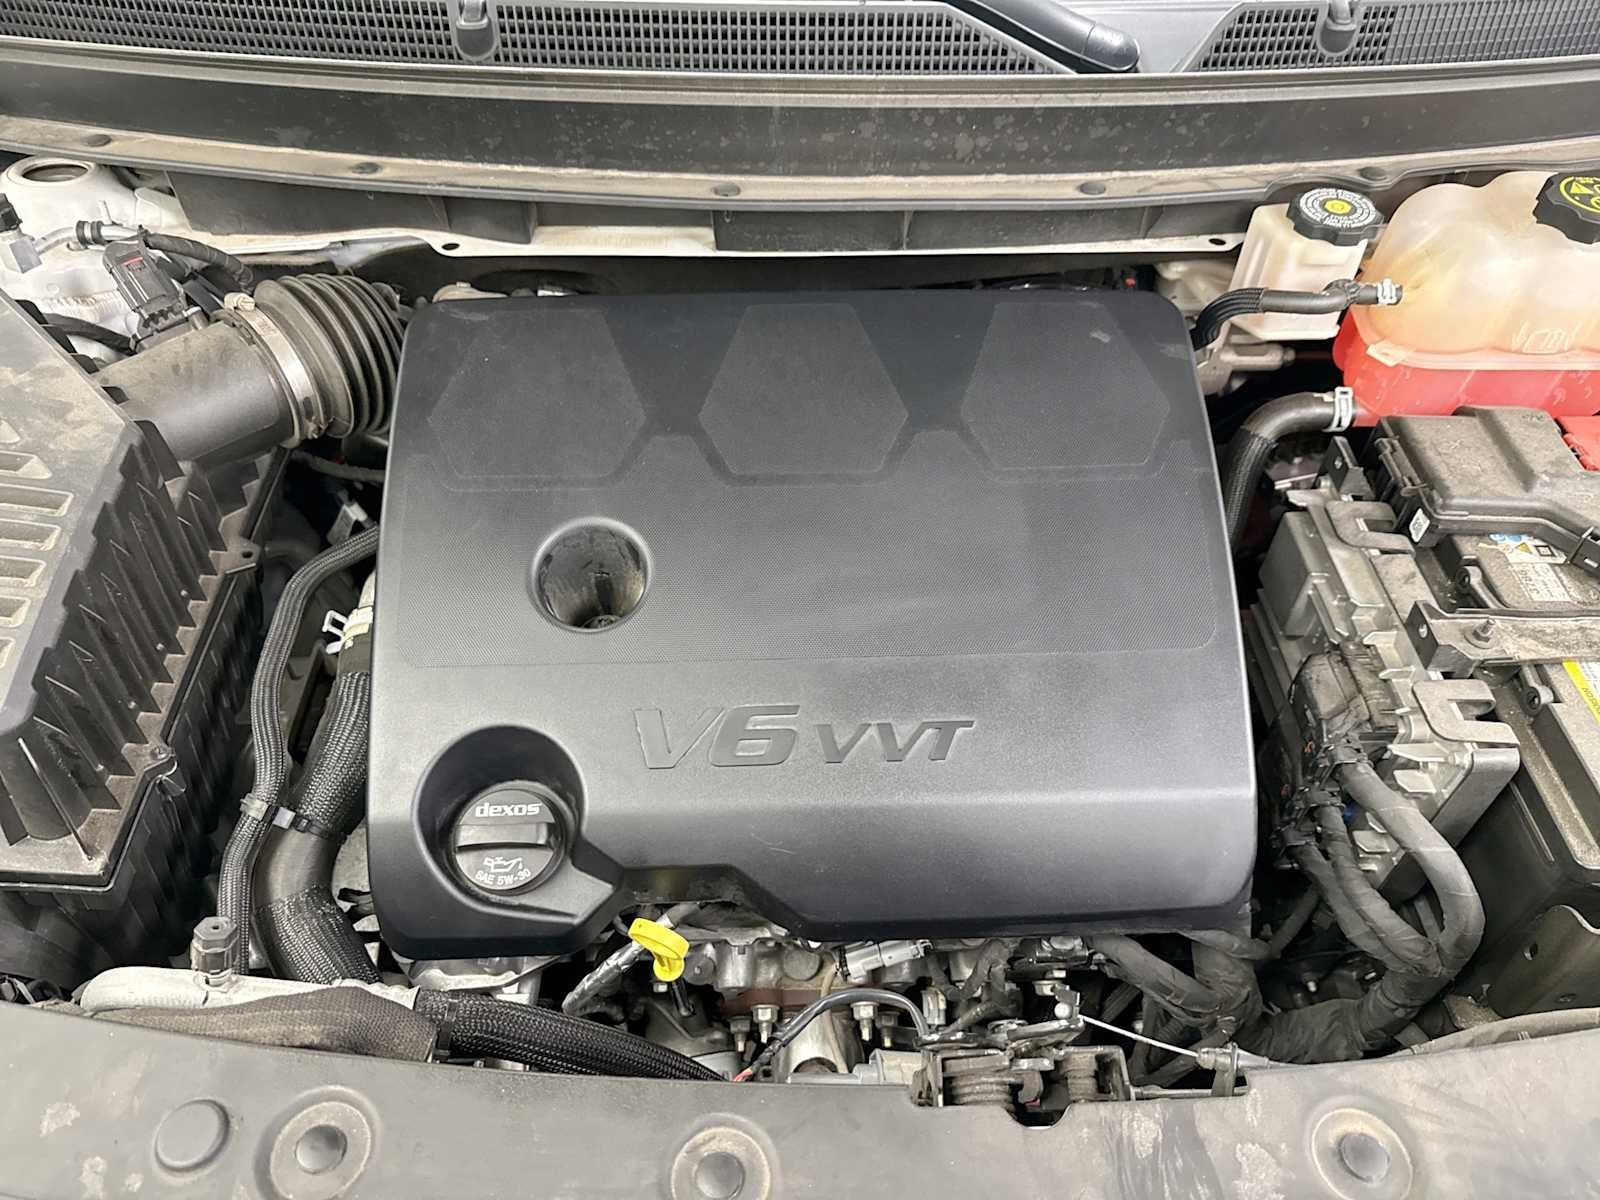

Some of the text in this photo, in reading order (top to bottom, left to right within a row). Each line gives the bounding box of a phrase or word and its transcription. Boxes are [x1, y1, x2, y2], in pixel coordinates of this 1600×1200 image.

[633, 704, 975, 769] V6 VVT
[475, 802, 543, 817] dexos
[475, 868, 531, 886] SAE 5W-30
